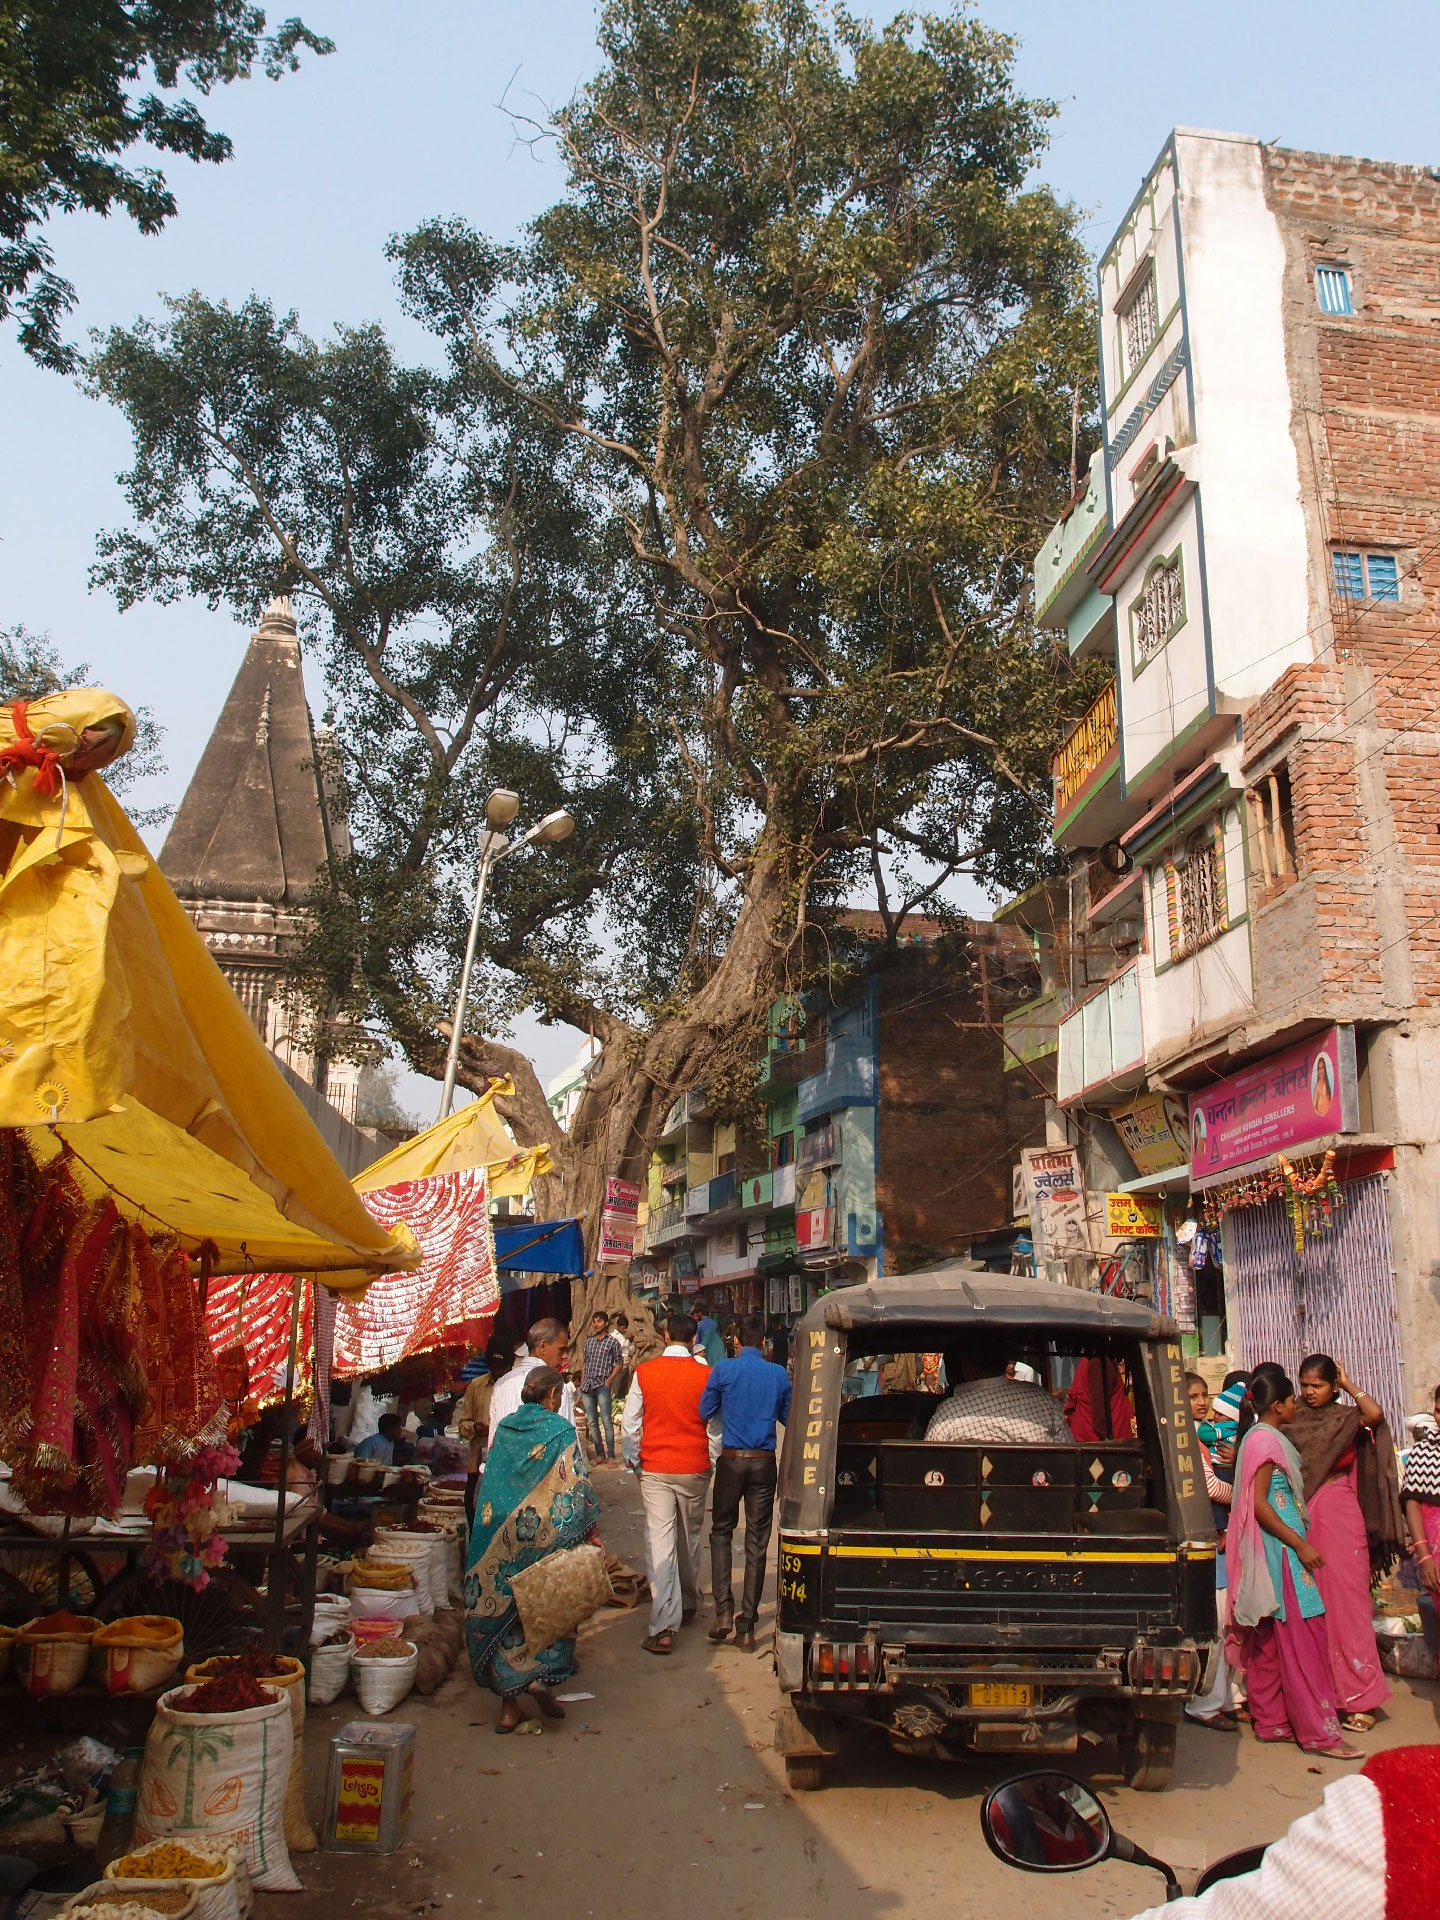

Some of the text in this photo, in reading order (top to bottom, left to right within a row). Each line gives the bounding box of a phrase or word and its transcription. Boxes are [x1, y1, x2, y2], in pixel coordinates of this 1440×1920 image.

[1263, 1105, 1295, 1125] JEWELLERS
[1029, 1153, 1073, 1171] प्रतिमा
[1033, 1167, 1074, 1188] ज्वेलर्स
[1109, 1199, 1131, 1208] उत्तम
[1111, 1222, 1134, 1234] गिफ्ट
[803, 1331, 826, 1485] WELCOME
[1167, 1343, 1194, 1498] WELCOME
